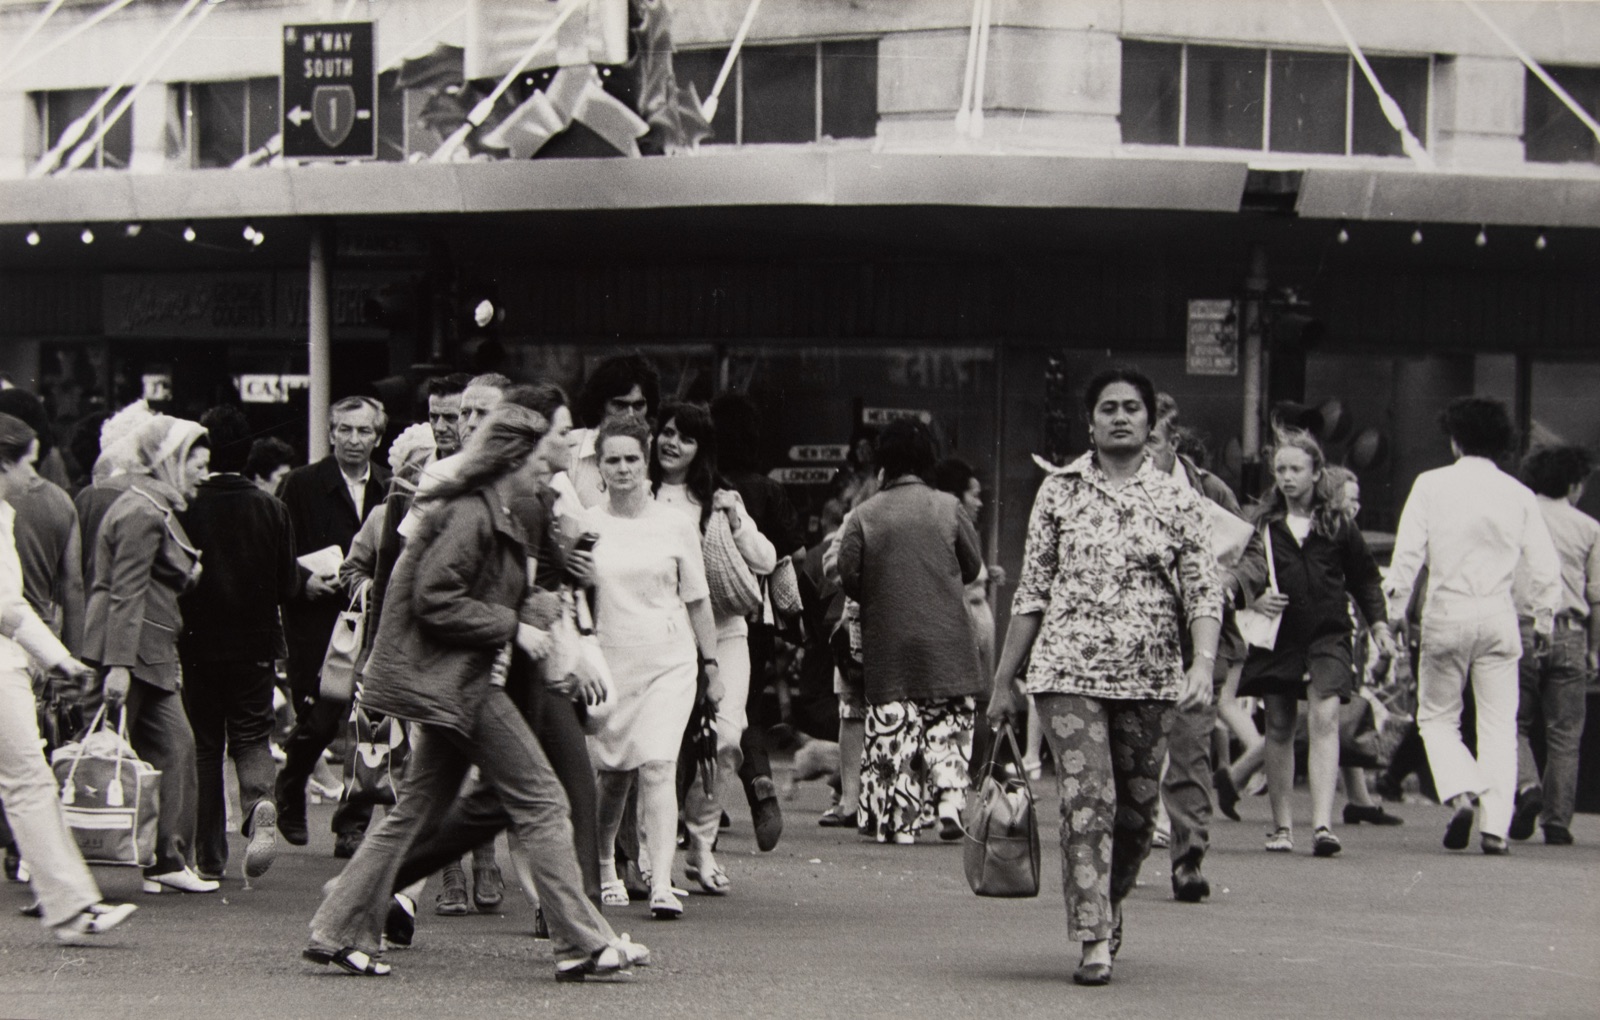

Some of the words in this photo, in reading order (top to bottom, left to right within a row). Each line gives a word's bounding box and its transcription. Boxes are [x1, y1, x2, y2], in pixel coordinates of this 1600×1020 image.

[303, 58, 353, 78] SOUTH
[799, 447, 818, 458] NEW
[821, 447, 841, 458] YORK
[782, 470, 829, 481] LONDON
